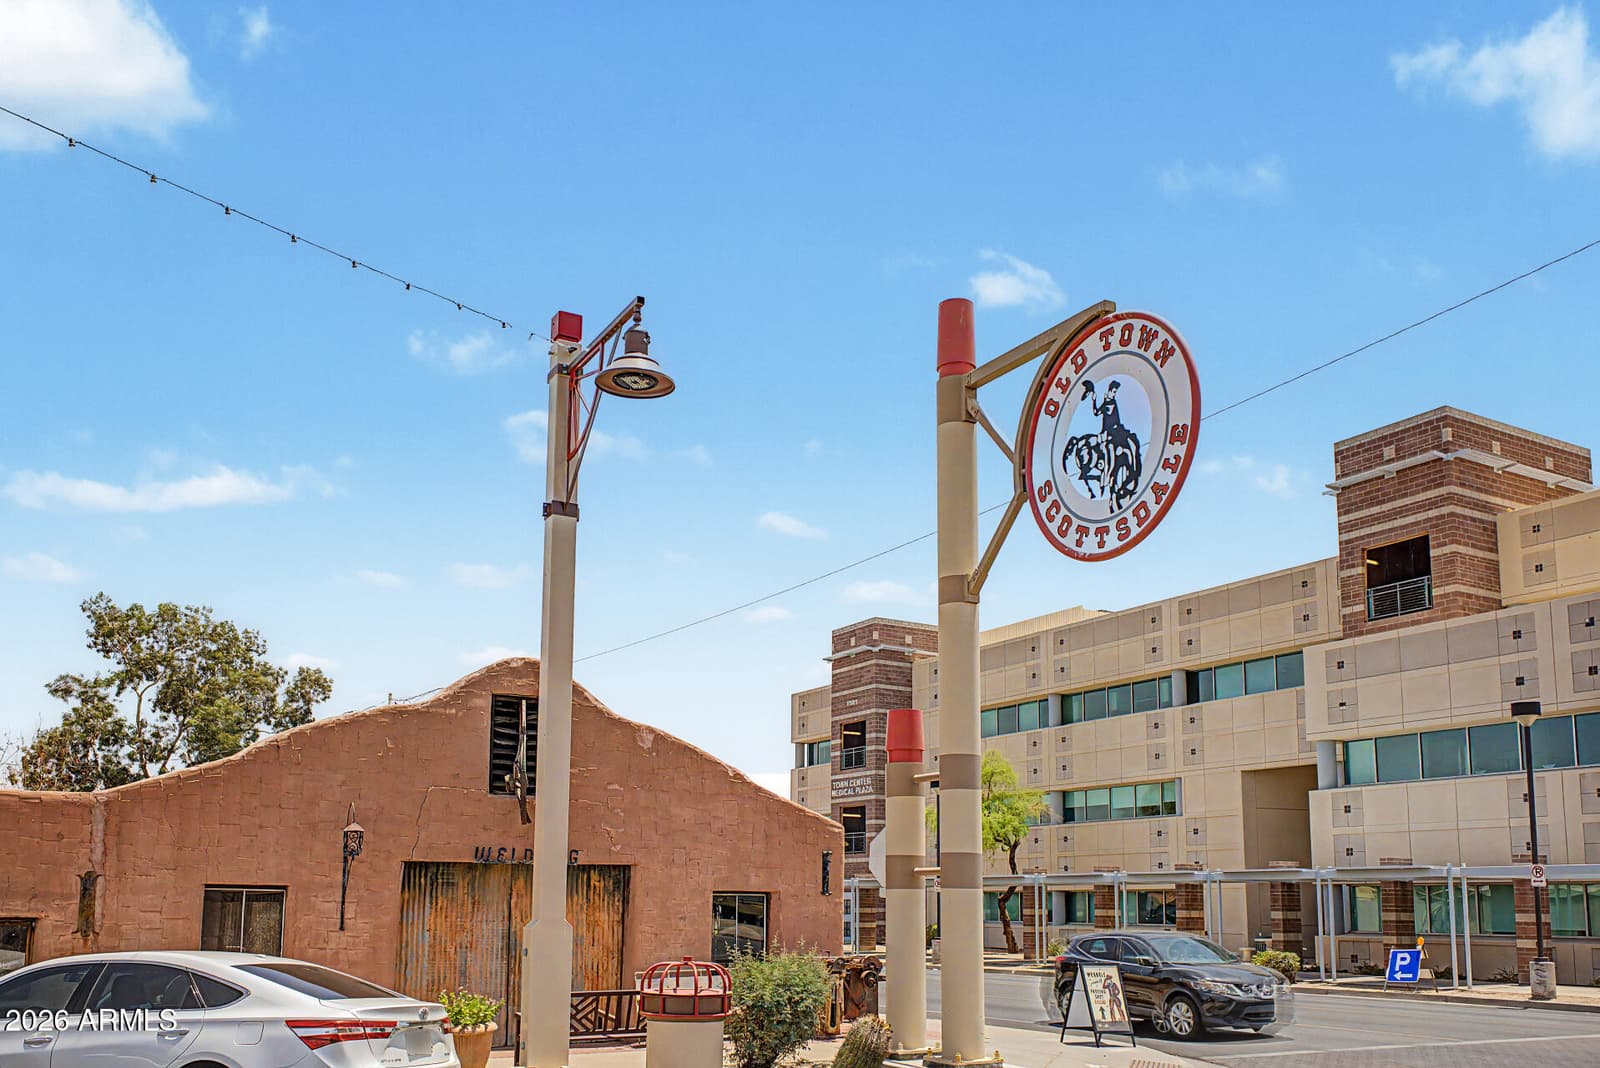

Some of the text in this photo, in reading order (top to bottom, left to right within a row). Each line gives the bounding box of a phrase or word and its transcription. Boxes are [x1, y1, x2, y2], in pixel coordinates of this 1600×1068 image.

[1044, 321, 1176, 418] OLD TOWN
[1037, 422, 1189, 550] SCOTTSDALE
[831, 784, 874, 797] MEDICAL PLAZA
[832, 777, 872, 789] TOWN CENTER
[474, 845, 580, 865] WELDG
[1394, 952, 1411, 971] P
